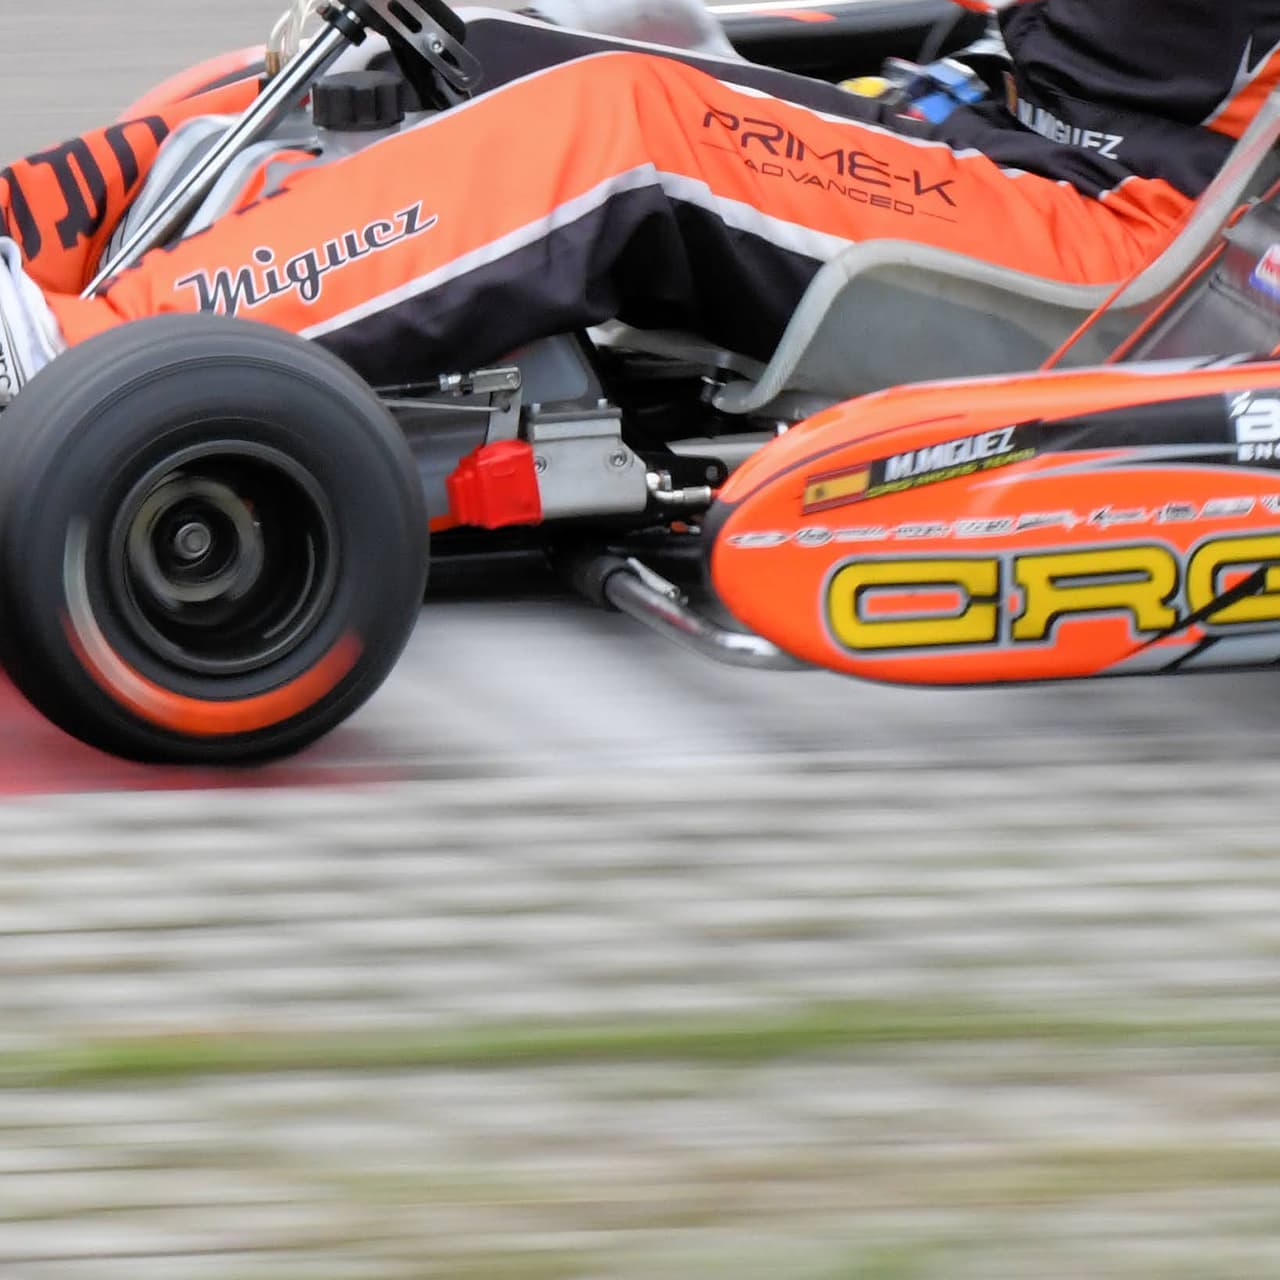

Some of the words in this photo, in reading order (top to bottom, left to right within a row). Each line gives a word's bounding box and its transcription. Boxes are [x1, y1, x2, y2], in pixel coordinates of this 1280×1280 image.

[703, 111, 957, 208] PRIME-K
[744, 159, 915, 216] ADVANCED
[175, 202, 438, 320] Miguez
